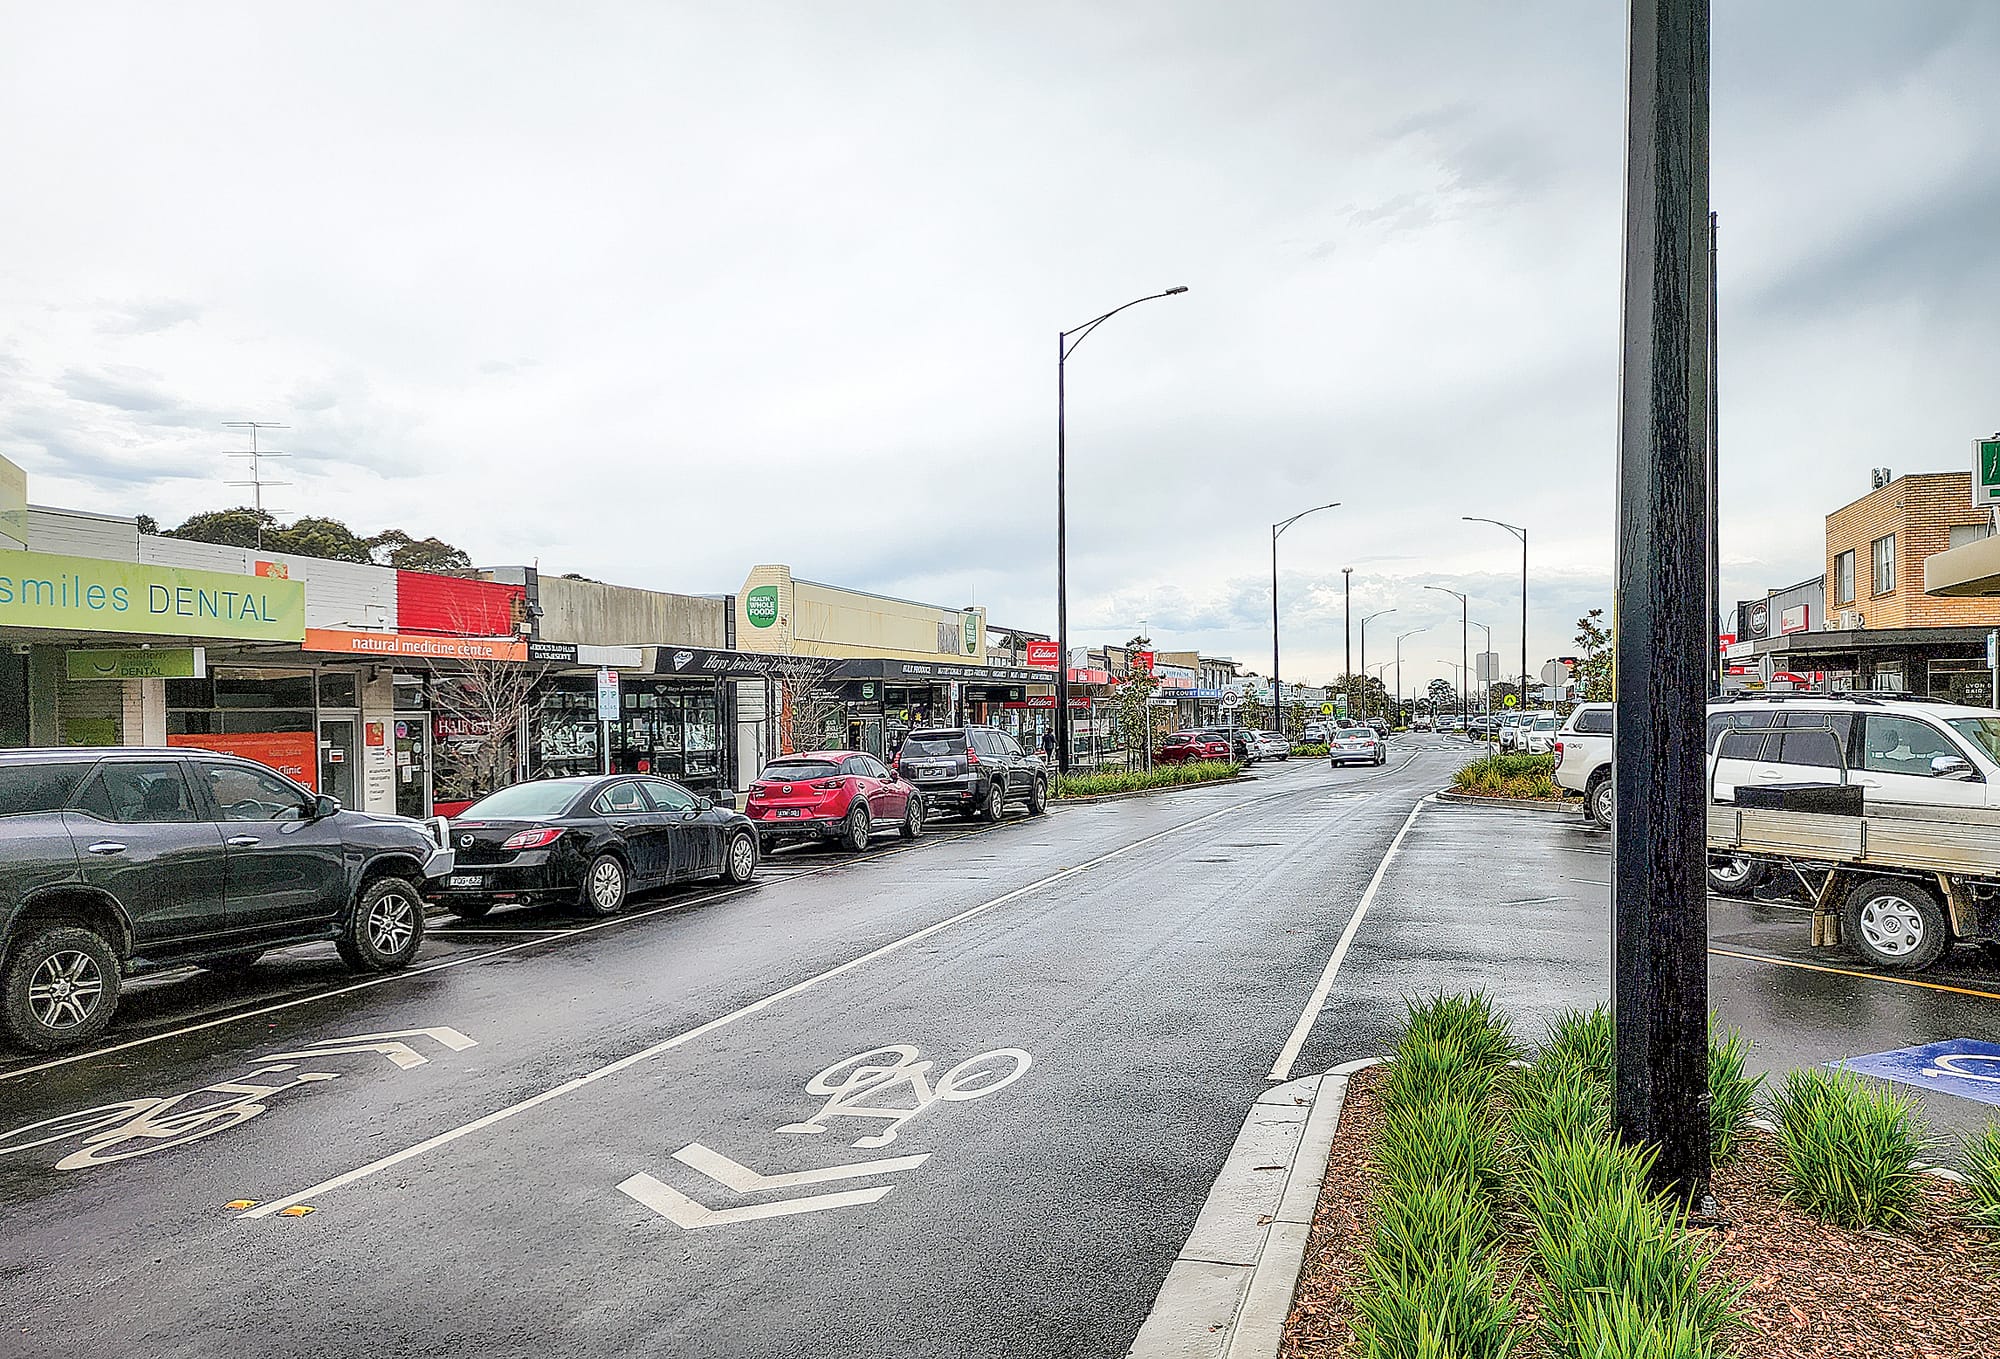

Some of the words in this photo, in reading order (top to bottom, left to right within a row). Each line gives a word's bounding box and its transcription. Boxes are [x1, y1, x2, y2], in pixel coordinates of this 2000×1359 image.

[0, 574, 129, 612] smiles
[149, 584, 278, 622] DENTAL
[351, 637, 400, 652] natural
[402, 640, 457, 655] medicine
[458, 643, 493, 657] centre
[1032, 647, 1057, 659] Elders
[702, 654, 728, 672] Hays
[727, 655, 770, 673] Jewellers
[121, 667, 164, 677] DENTAL
[1027, 696, 1052, 706] Elders
[1225, 694, 1236, 703] 40
[278, 765, 302, 775] Clinic
